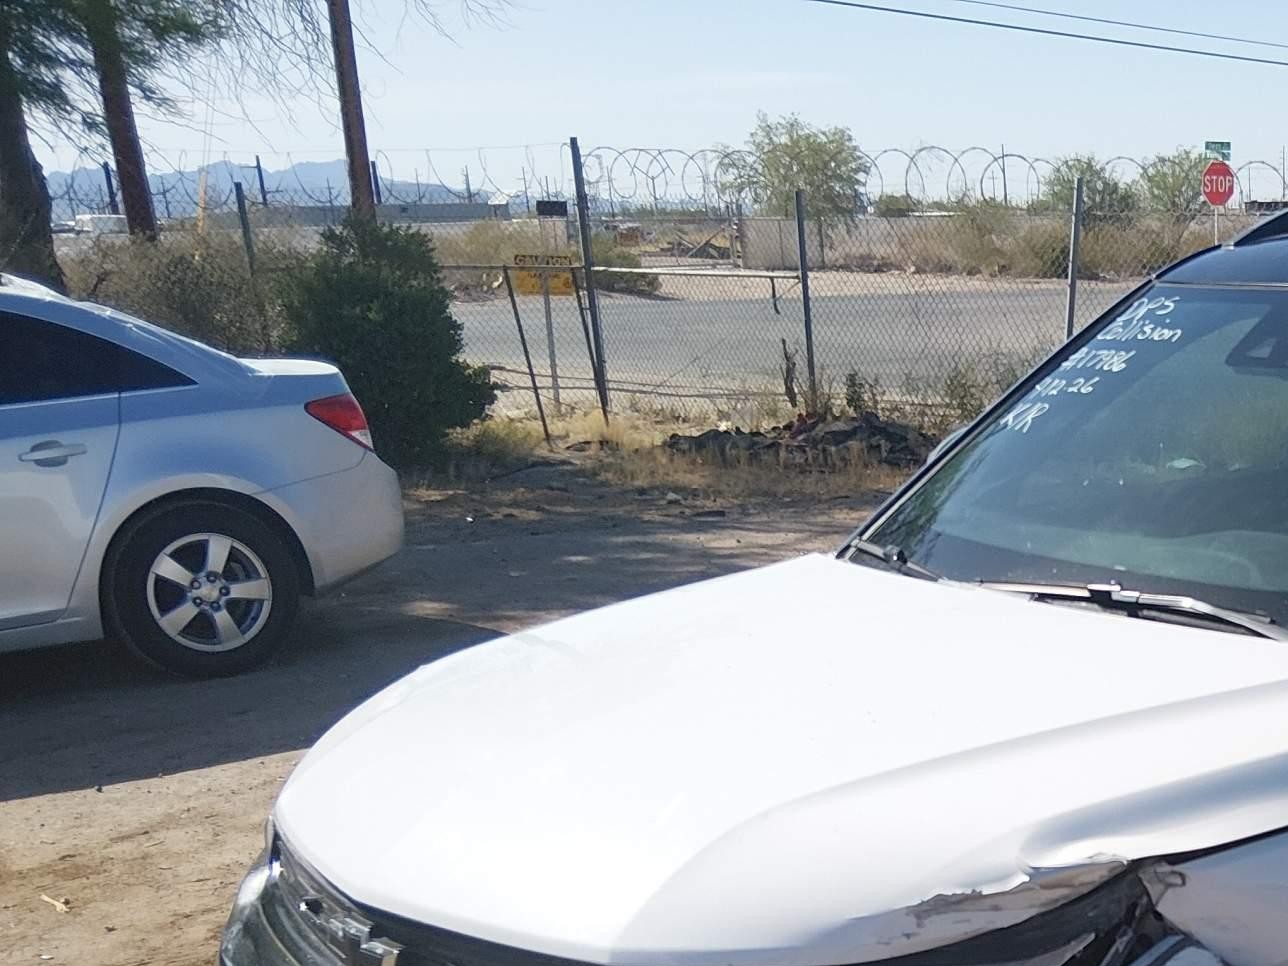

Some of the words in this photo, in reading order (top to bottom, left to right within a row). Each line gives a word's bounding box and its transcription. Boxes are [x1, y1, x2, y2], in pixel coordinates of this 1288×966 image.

[1204, 175, 1233, 193] STOP
[1116, 296, 1180, 323] DPS
[1097, 320, 1182, 342] Collision
